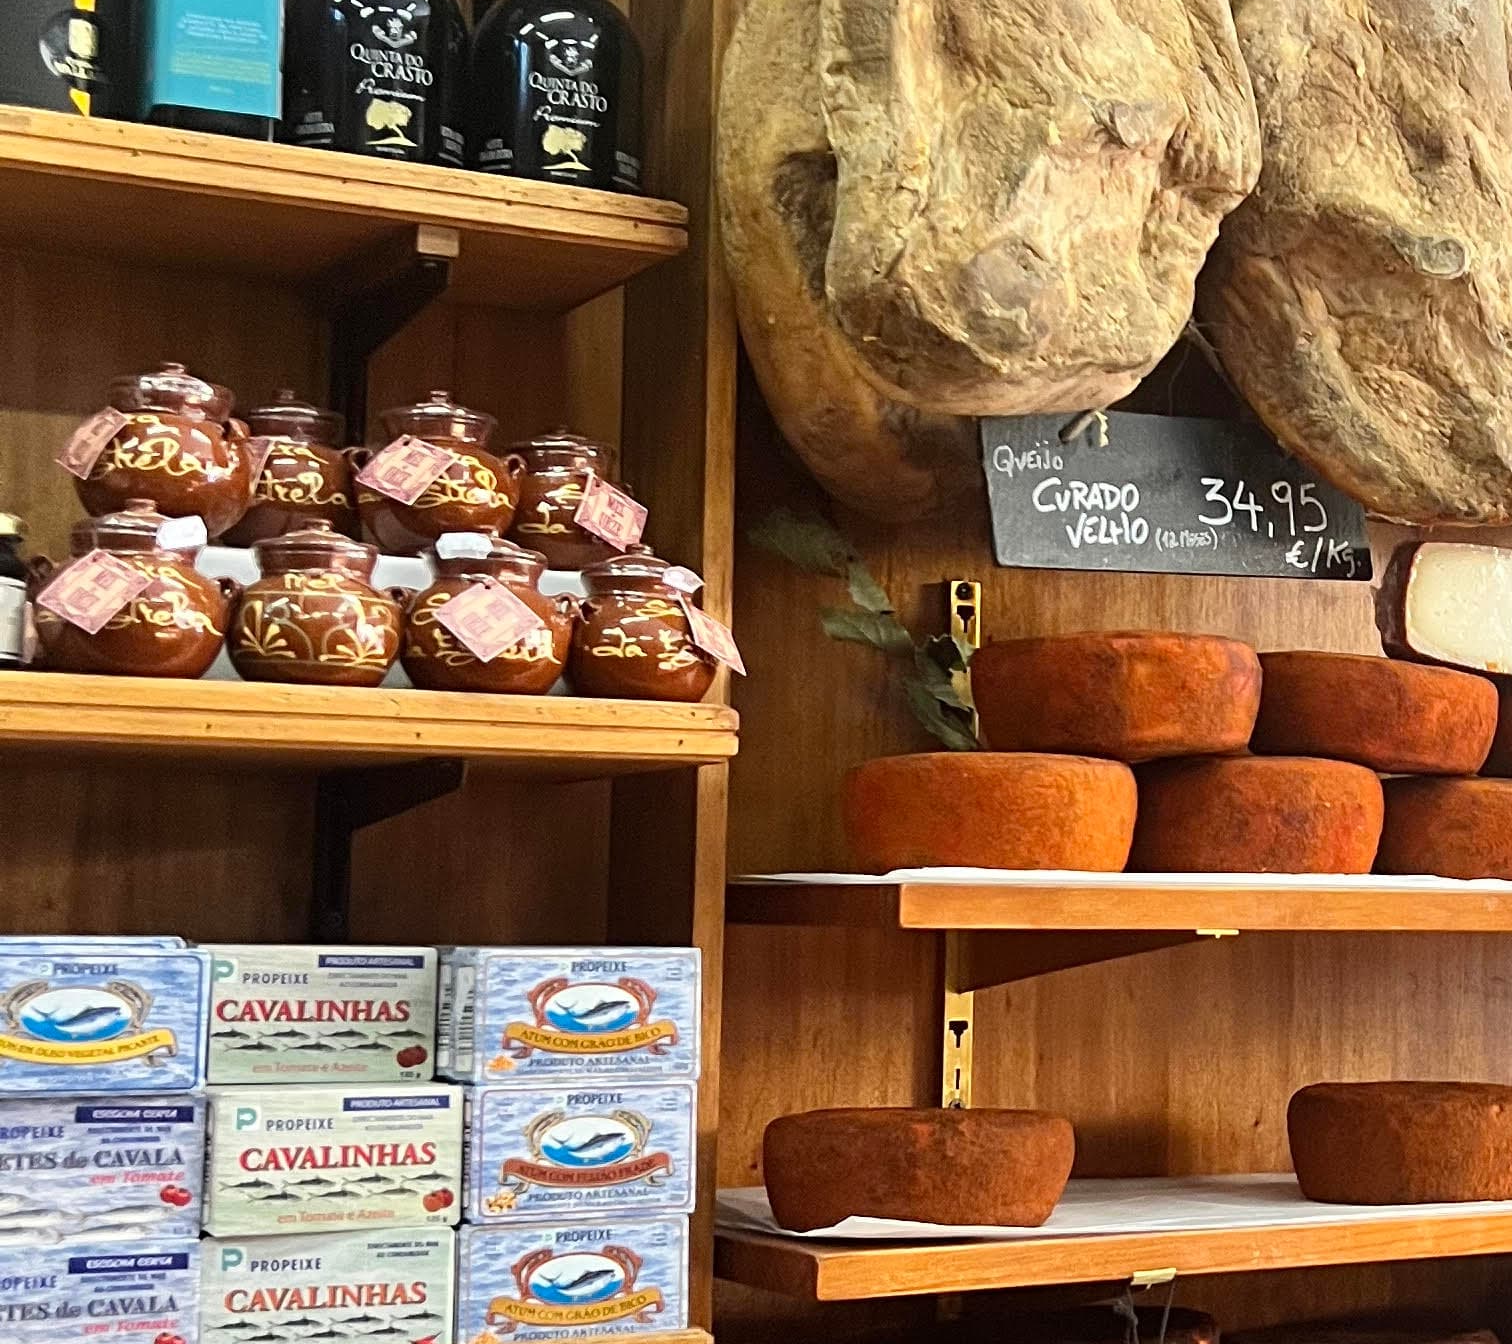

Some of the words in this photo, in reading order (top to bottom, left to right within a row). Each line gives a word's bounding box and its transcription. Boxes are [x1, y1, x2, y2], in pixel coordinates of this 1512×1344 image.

[350, 42, 403, 65] QUINTA
[404, 52, 424, 68] DO
[371, 60, 434, 87] CRASTO
[528, 70, 578, 94] QUINTA
[579, 79, 600, 96] DO
[546, 89, 609, 113] CRASTO
[1198, 476, 1330, 539] 34,95
[242, 972, 309, 985] PROPEIXE
[570, 961, 629, 974] PROPEIXE
[215, 999, 412, 1024] CAVALINHAS
[566, 1092, 624, 1106] PROPEIXE
[0, 1125, 65, 1140] ROPEIXE
[265, 1117, 335, 1132] PROPEIXE
[92, 1147, 186, 1169] CAVALA
[238, 1141, 438, 1173] CAVALINHAS
[555, 1229, 614, 1244] PROPEIXE
[250, 1257, 323, 1273] PROPEIXE
[87, 1294, 180, 1318] CAVALA
[223, 1280, 428, 1315] CAVALINHAS
